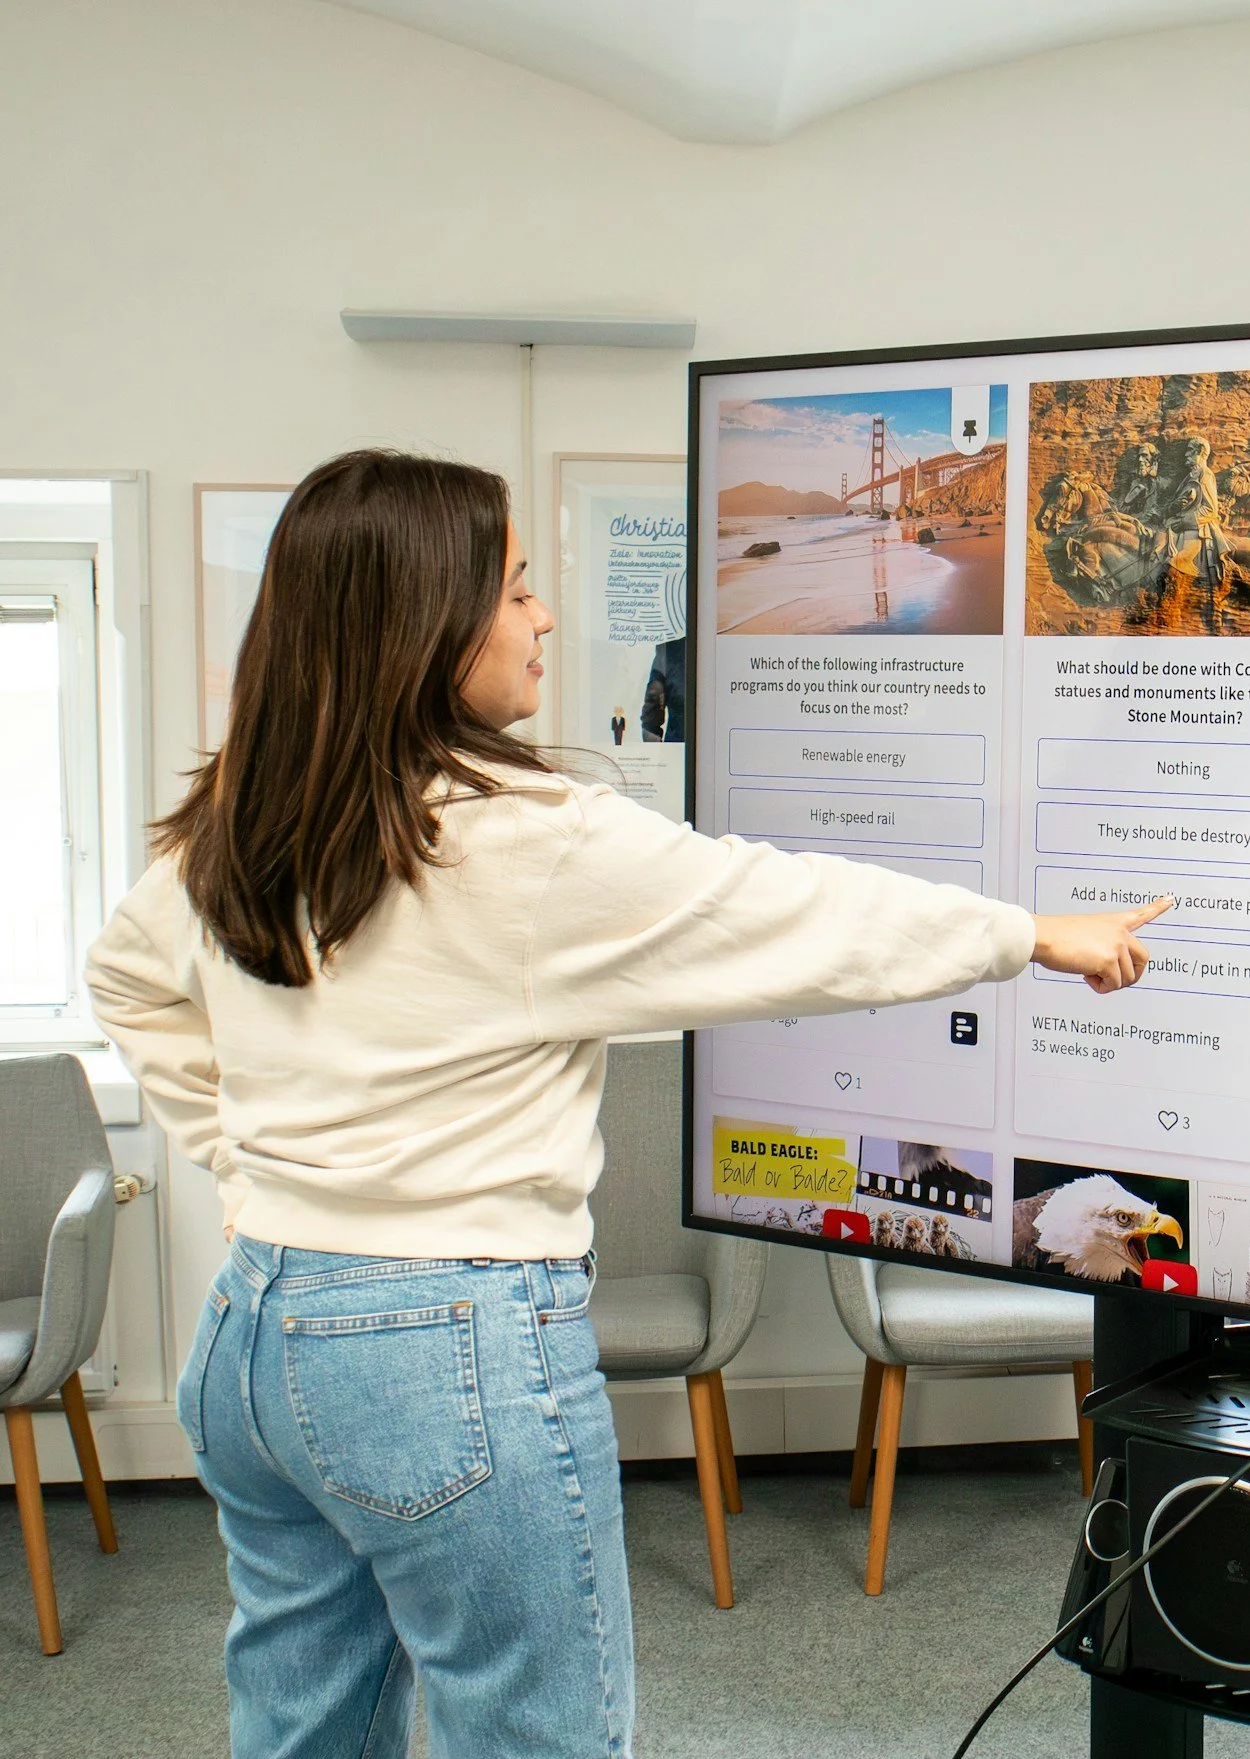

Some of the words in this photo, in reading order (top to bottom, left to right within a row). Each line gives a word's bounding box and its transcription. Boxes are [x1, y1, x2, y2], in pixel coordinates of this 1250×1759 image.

[610, 621, 642, 634] Change
[608, 632, 664, 647] Management
[750, 656, 785, 669] Which
[787, 656, 800, 670] of
[801, 657, 821, 670] the
[823, 657, 878, 674] following
[880, 657, 964, 671] infrastructure
[1056, 660, 1091, 674] What
[1093, 660, 1139, 674] should
[1142, 661, 1159, 674] be
[1162, 661, 1197, 675] done
[1200, 661, 1231, 676] with
[730, 681, 784, 694] programs
[786, 678, 801, 691] do
[803, 682, 825, 695] you
[827, 679, 858, 692] think
[861, 683, 882, 692] our
[883, 681, 931, 697] country
[933, 681, 970, 694] needs
[973, 682, 986, 695] to
[1054, 685, 1102, 697] statues
[1105, 684, 1130, 698] and
[1133, 687, 1216, 700] monuments
[1220, 686, 1245, 700] like
[800, 700, 831, 714] focus
[833, 704, 848, 714] on
[851, 701, 871, 714] the
[873, 702, 909, 715] most?
[1127, 708, 1167, 723] Stone
[1170, 709, 1243, 724] Mountain?
[802, 748, 864, 762] Renewable
[866, 752, 906, 767] energy
[1157, 760, 1211, 780] Nothing
[810, 808, 874, 826] High-speed
[877, 811, 895, 825] rail
[1097, 822, 1130, 841] They
[1132, 824, 1177, 840] should
[1181, 826, 1198, 841] be
[1070, 886, 1096, 901] Add
[1099, 891, 1107, 901] a
[1111, 888, 1182, 910] historicy
[1185, 896, 1243, 910] accurate
[1148, 957, 1189, 973] public
[1191, 959, 1198, 976] /
[1201, 963, 1224, 977] put
[1227, 962, 1240, 977] in
[1032, 1016, 1068, 1031] WETA
[1071, 1019, 1220, 1050] National-Programming
[855, 1077, 863, 1089] 1
[1182, 1116, 1190, 1129] 3
[731, 1140, 766, 1155] BALD
[771, 1143, 818, 1160] EAGLE:
[720, 1157, 756, 1186] Bald
[765, 1170, 781, 1187] or
[790, 1164, 848, 1194] Balde?
